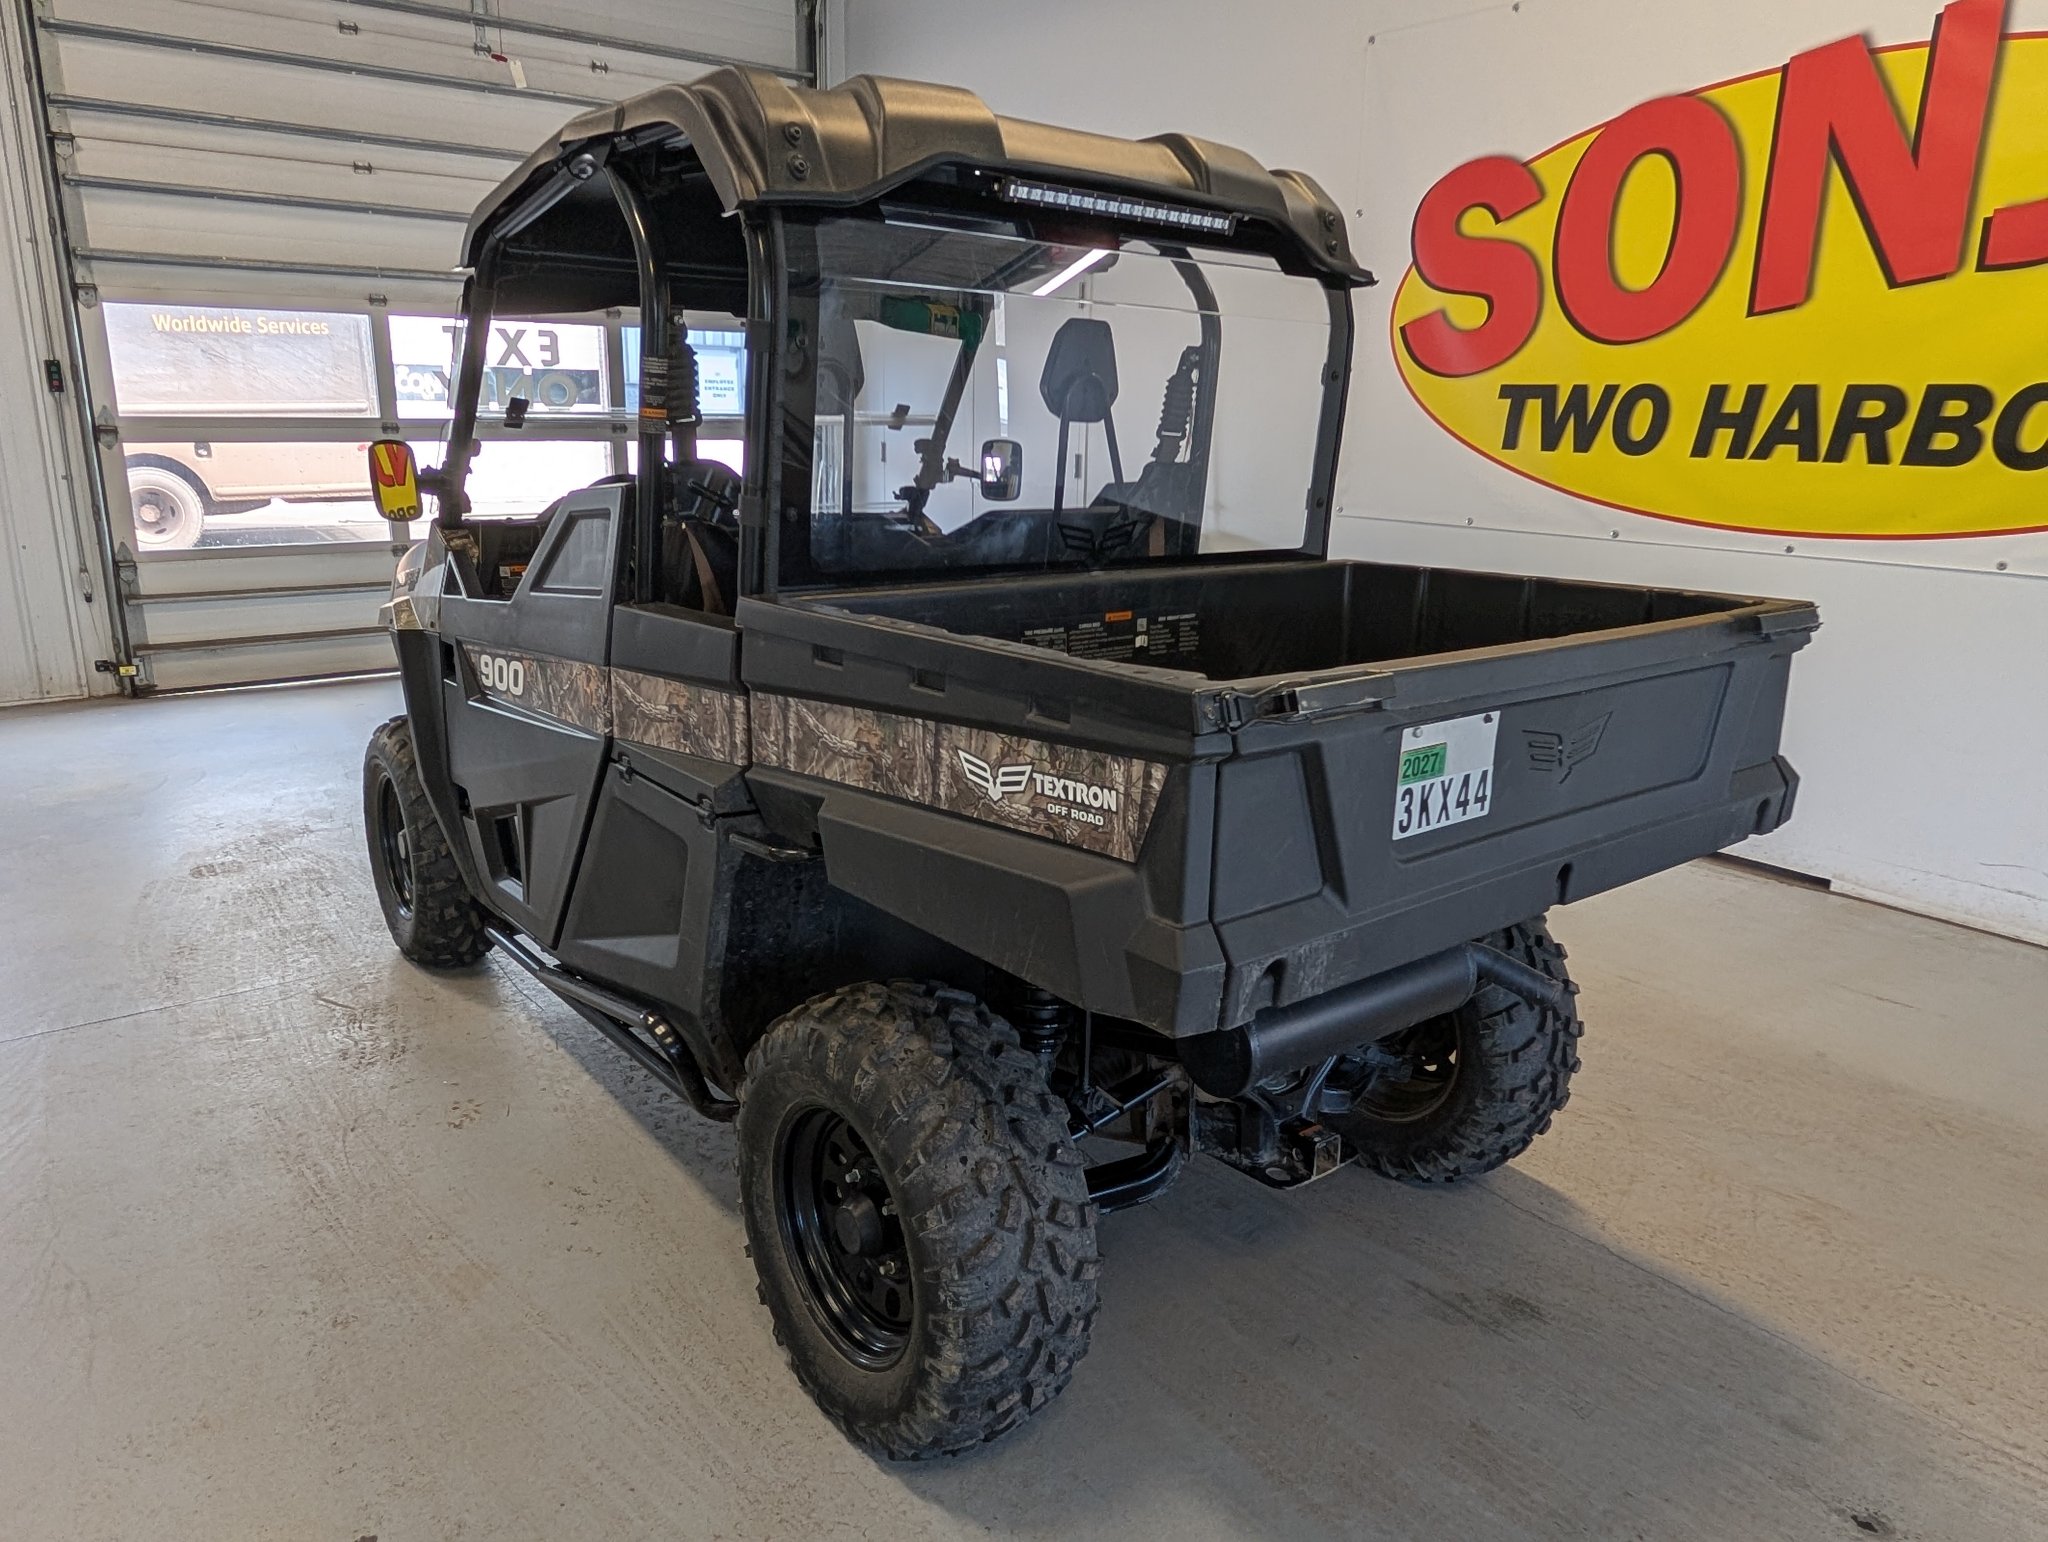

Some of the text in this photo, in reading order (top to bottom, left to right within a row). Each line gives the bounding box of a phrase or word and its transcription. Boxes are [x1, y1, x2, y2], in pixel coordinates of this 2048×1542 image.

[151, 313, 330, 336] Worldwide Services
[1497, 383, 2048, 472] TWO HARBO
[480, 654, 524, 696] 900
[1402, 752, 1440, 780] 2027
[1032, 772, 1118, 813] TEXTRON
[1398, 769, 1489, 834] 3KX44
[1047, 803, 1104, 826] OFF ROAD
